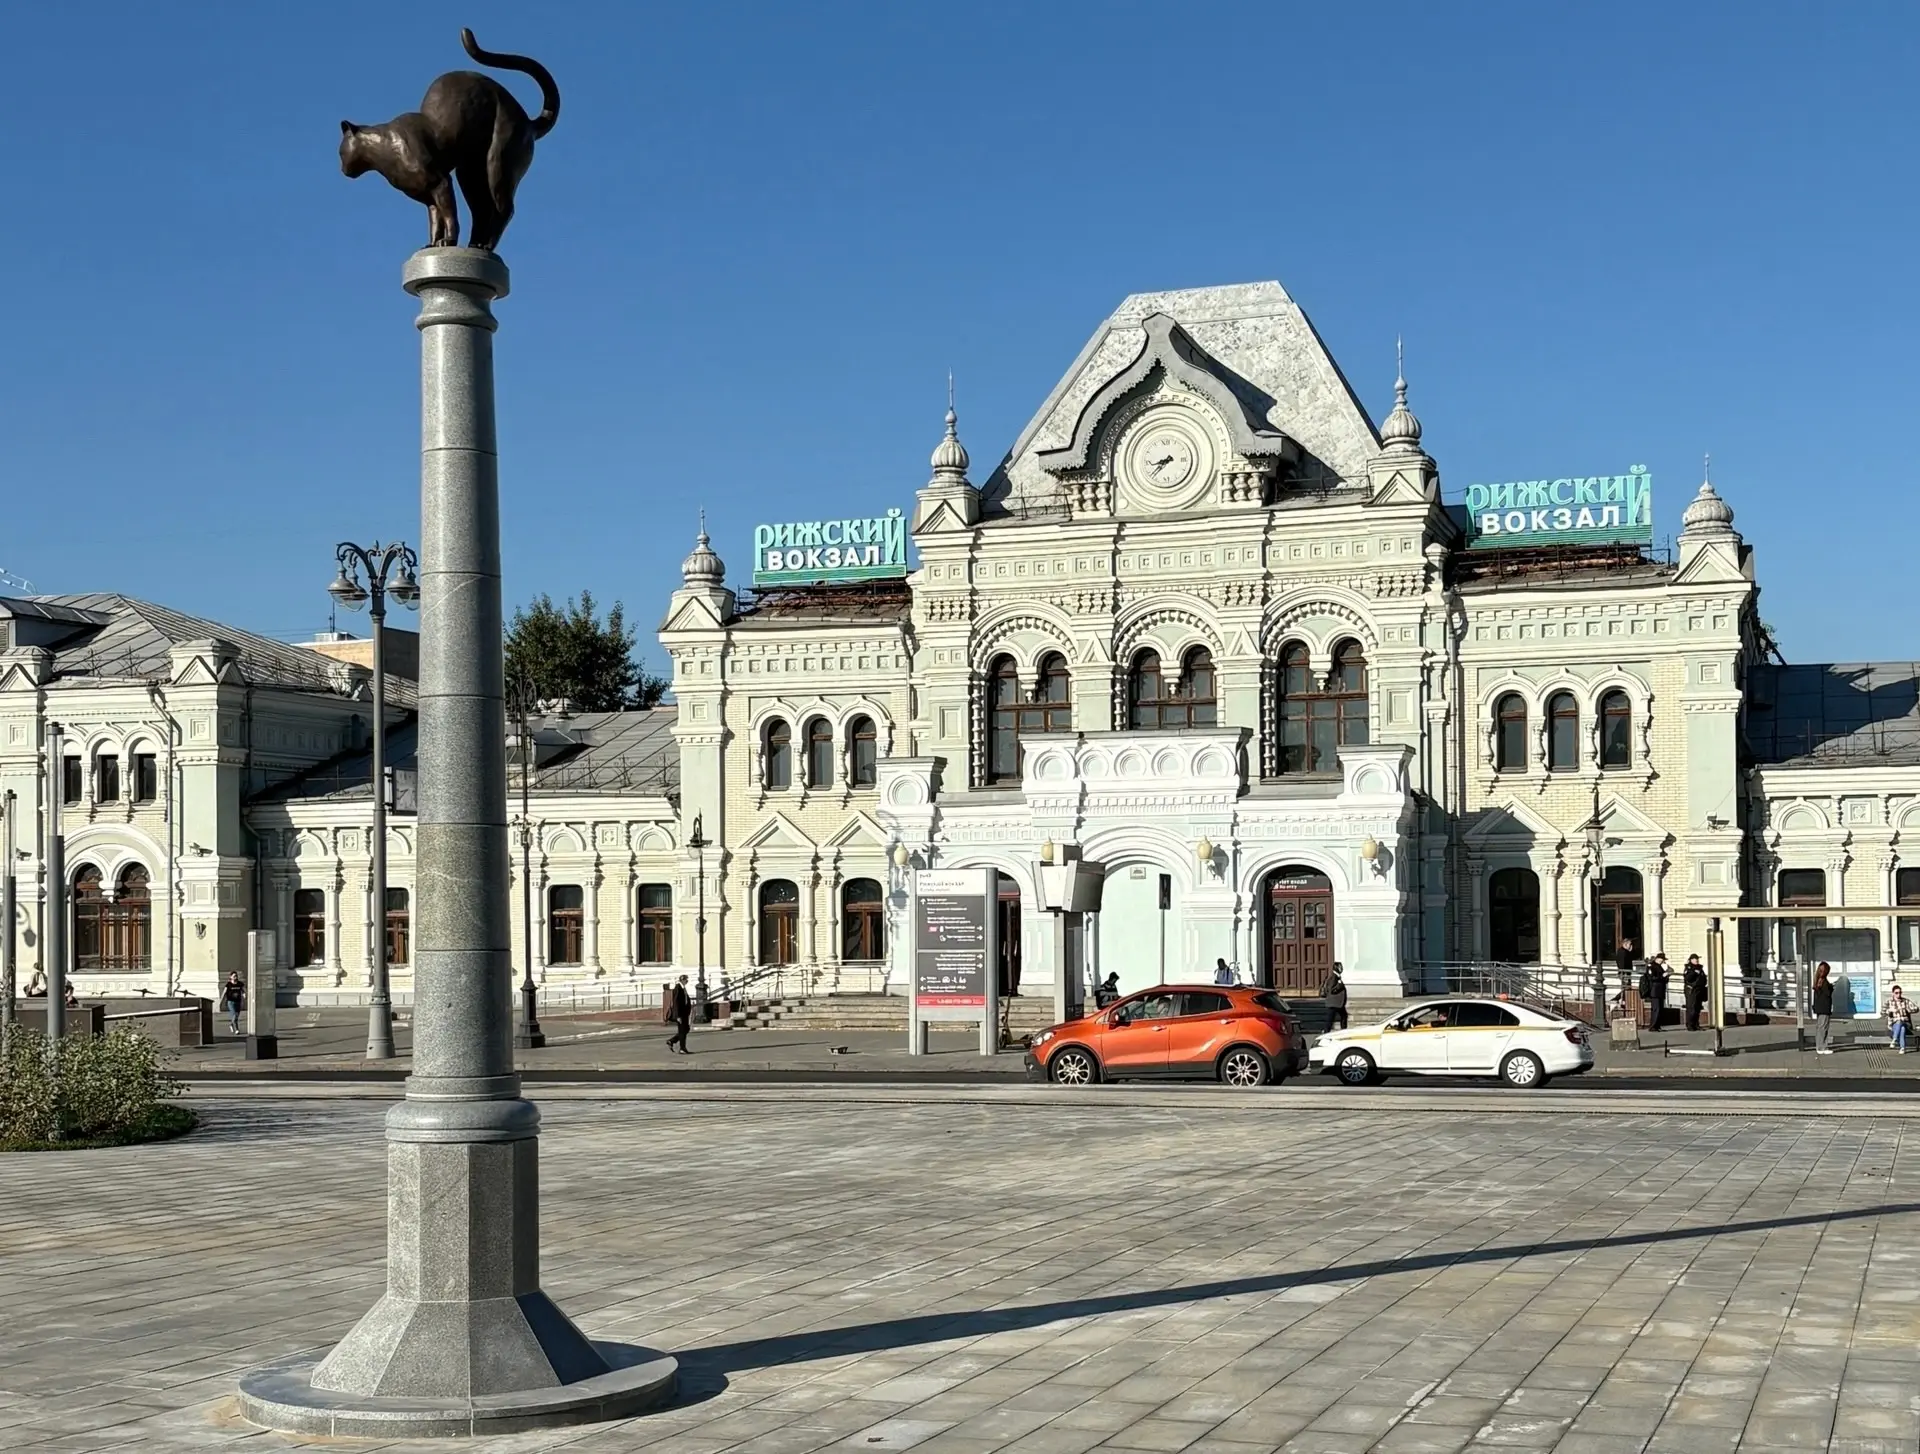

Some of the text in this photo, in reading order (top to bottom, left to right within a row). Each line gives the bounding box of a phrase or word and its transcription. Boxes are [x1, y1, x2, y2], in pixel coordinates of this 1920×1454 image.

[1465, 464, 1652, 533] РИЖСКИЙ
[1481, 505, 1620, 535] ВОКЗАЛ
[754, 508, 906, 572] РИЖСКИЙ
[767, 545, 880, 571] ВОКЗАЛ
